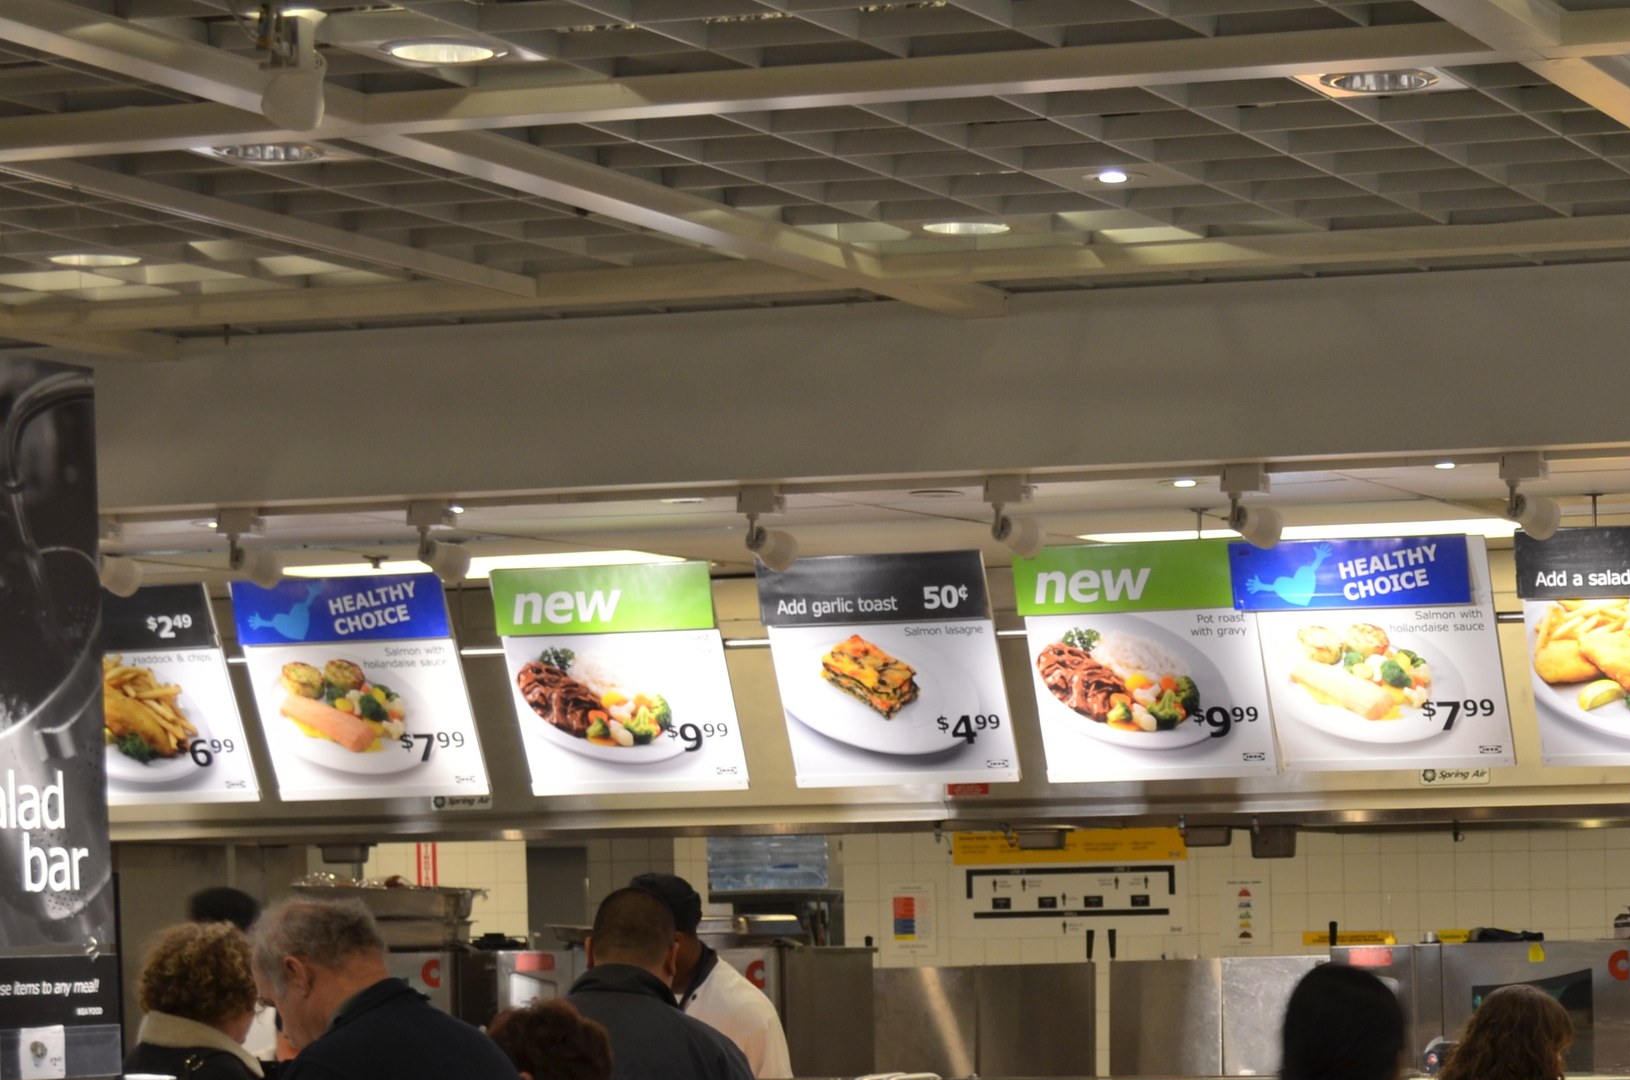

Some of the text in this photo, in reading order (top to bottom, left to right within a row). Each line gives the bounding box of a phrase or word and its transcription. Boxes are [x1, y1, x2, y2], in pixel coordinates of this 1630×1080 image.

[1338, 543, 1438, 580] HEALTHY
[1035, 567, 1151, 605] new
[1343, 569, 1429, 601] CHOICE
[1535, 571, 1567, 587] Add
[1572, 573, 1584, 586] a
[328, 581, 415, 615] HEALTHY
[513, 589, 622, 626] new
[777, 598, 807, 616] Add
[812, 597, 854, 617] garlic
[857, 596, 898, 612] toast
[334, 604, 411, 635] CHOICE
[1197, 613, 1245, 624] Pot roast
[1389, 622, 1485, 633] hollandaise sauce
[1415, 609, 1483, 621] Salmon with
[904, 625, 984, 637] Salmon lasagne
[1190, 626, 1247, 637] with gravy
[176, 738, 235, 767] 699
[1437, 769, 1487, 781] Spring Air
[0, 769, 65, 829] lad
[23, 832, 89, 892] bar
[13, 980, 40, 996] items
[42, 980, 52, 995] to
[54, 982, 72, 997] any
